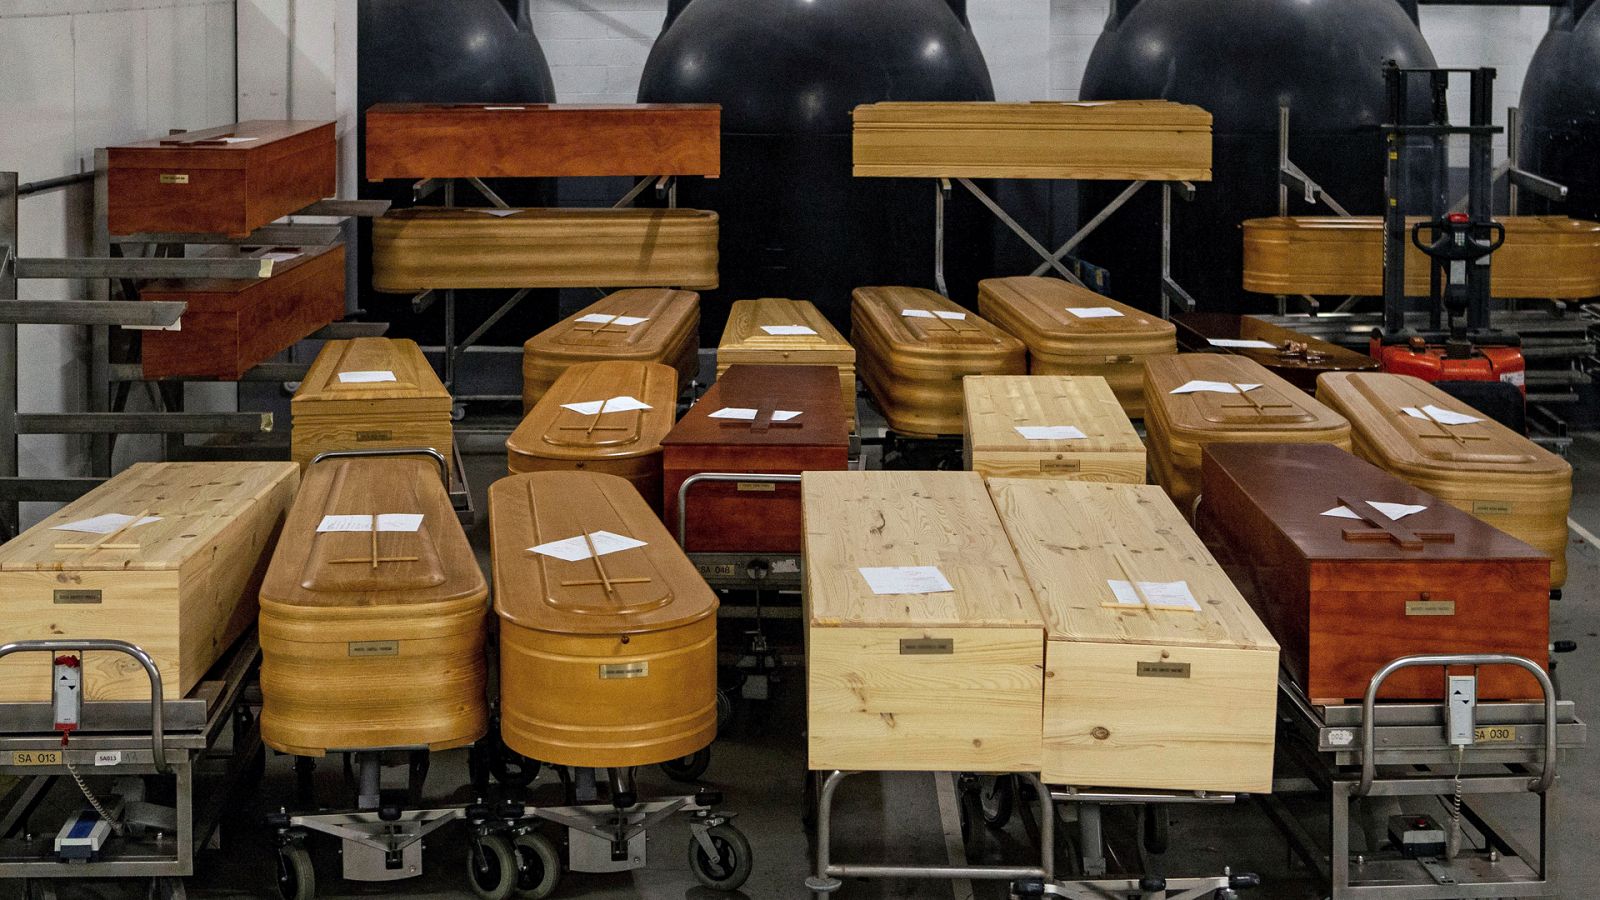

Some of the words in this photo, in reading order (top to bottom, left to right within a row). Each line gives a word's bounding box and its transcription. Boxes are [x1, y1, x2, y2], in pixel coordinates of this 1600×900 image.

[1475, 731, 1486, 740] SA
[1490, 729, 1509, 739] 030
[18, 753, 32, 763] SA
[37, 753, 56, 763] 013
